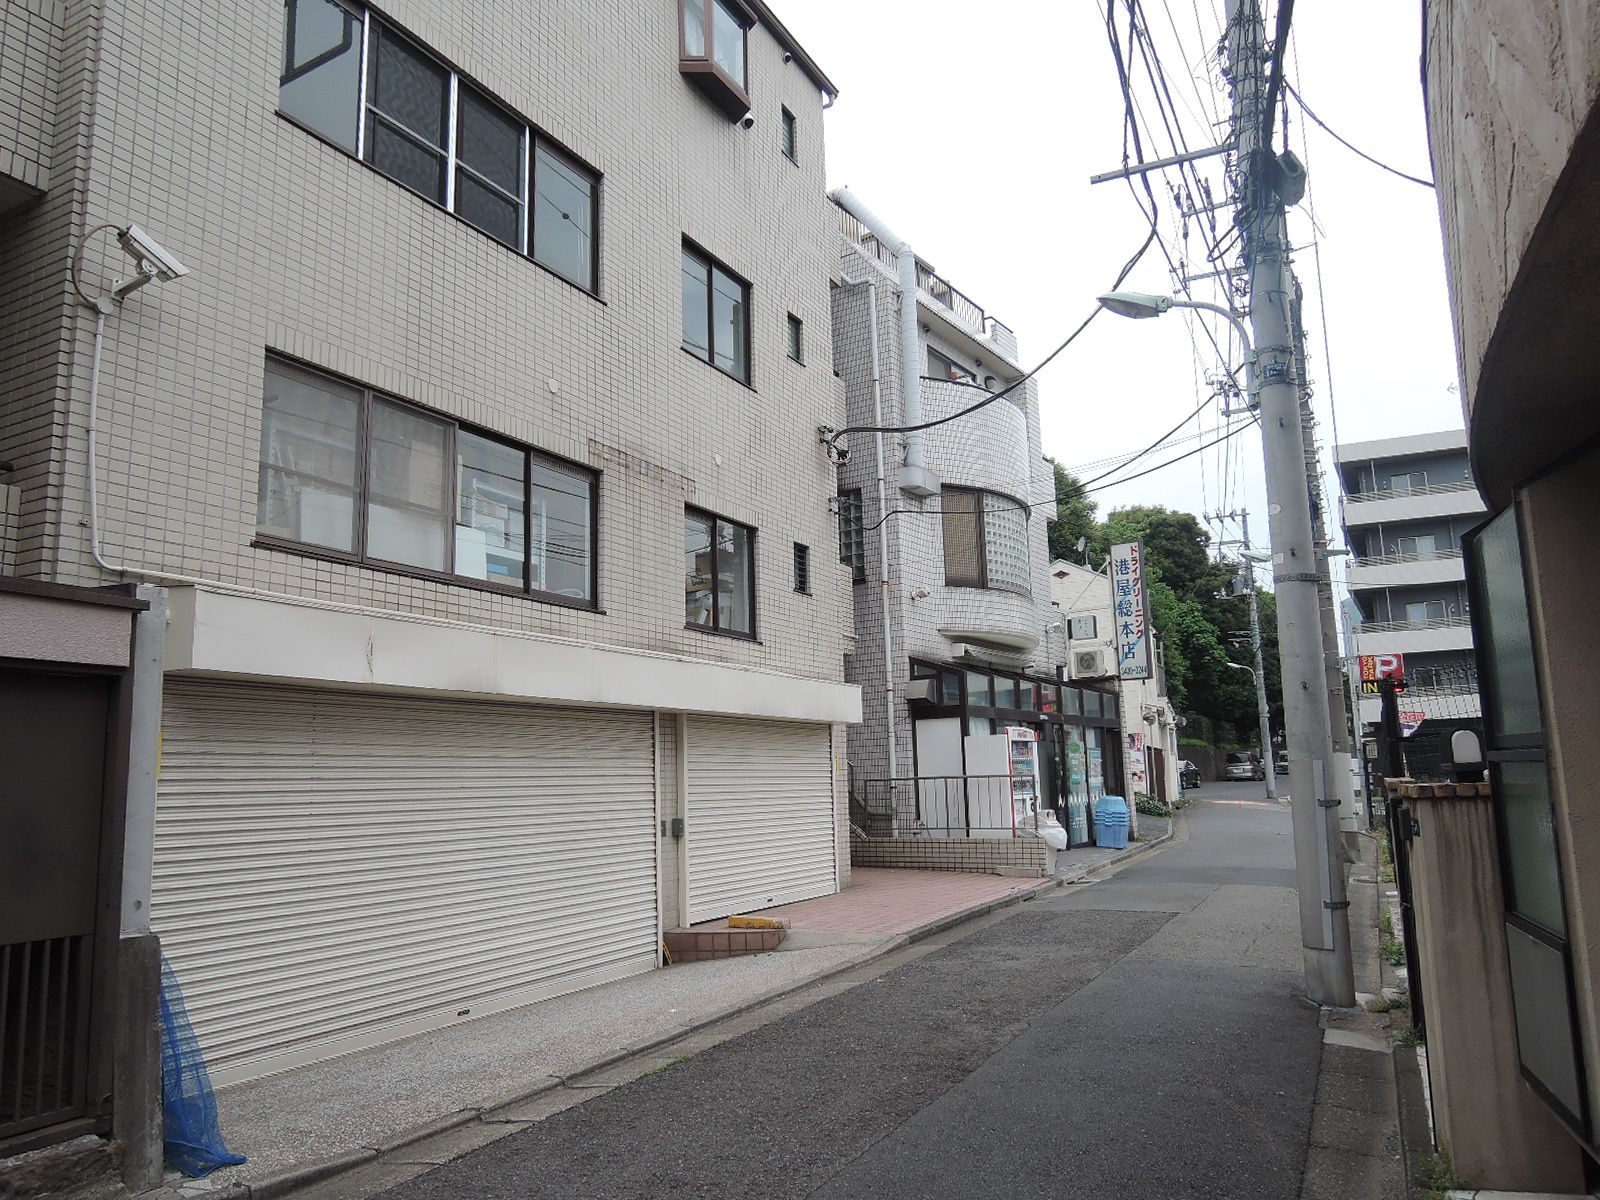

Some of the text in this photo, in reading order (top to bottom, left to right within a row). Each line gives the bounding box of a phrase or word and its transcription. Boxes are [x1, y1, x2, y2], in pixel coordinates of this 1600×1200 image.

[1114, 558, 1137, 660] 港屋総本店
[1130, 545, 1144, 639] ドライクリーニング
[1363, 682, 1379, 693] IN
[1375, 655, 1399, 679] P
